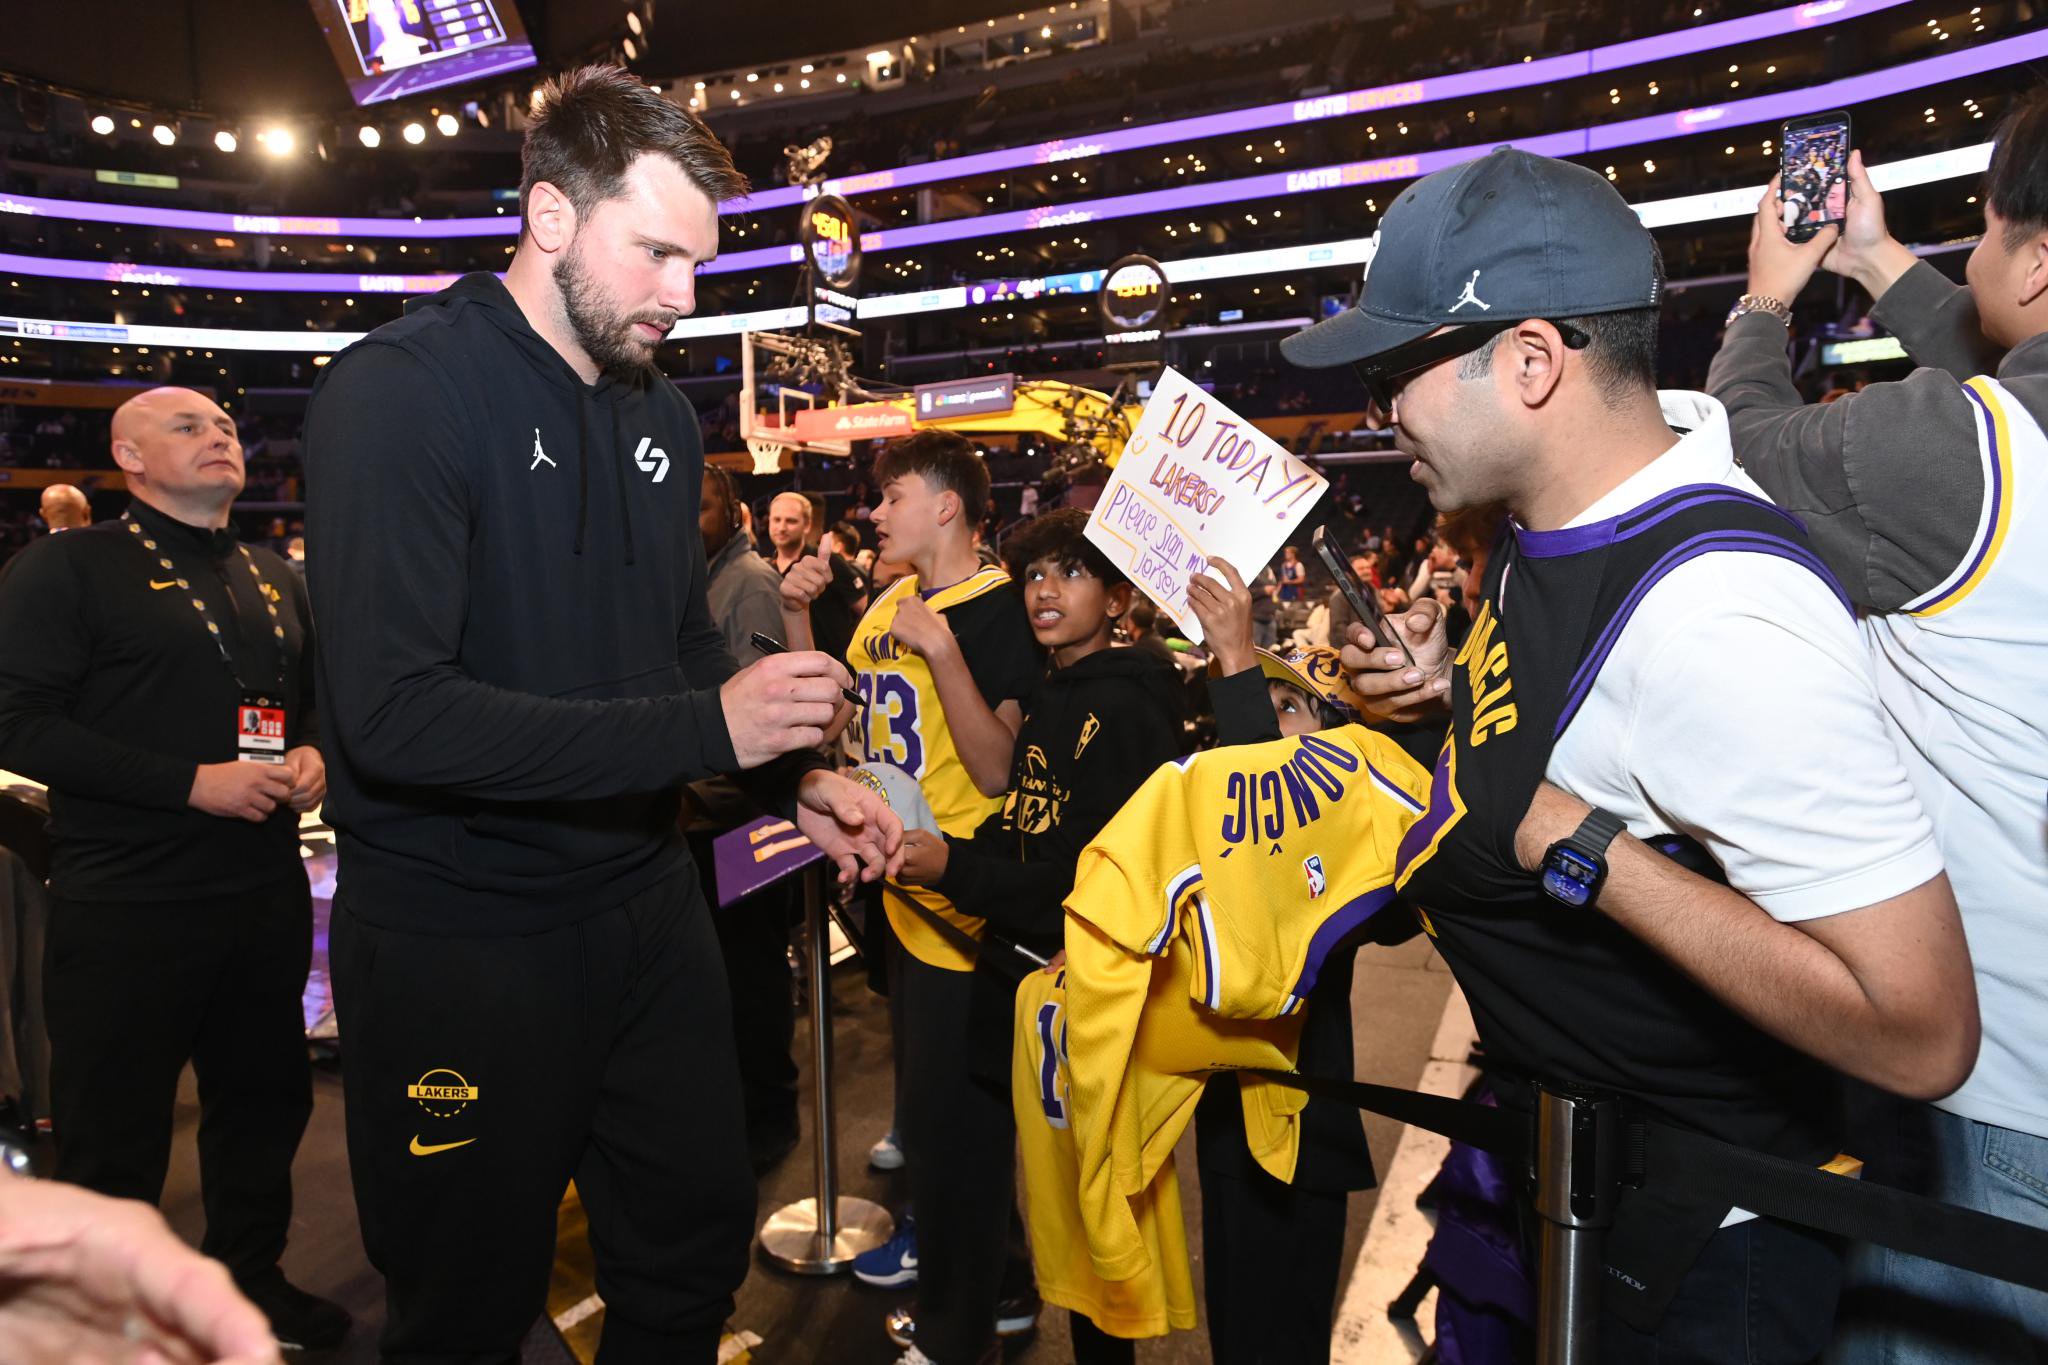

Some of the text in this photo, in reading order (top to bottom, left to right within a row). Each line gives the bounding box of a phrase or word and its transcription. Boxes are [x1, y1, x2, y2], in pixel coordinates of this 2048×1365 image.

[1158, 392, 1318, 520] 10 TODAY!
[1105, 484, 1157, 542] Please
[1150, 453, 1226, 531] LAKERS!
[416, 1087, 469, 1098] LAKERS
